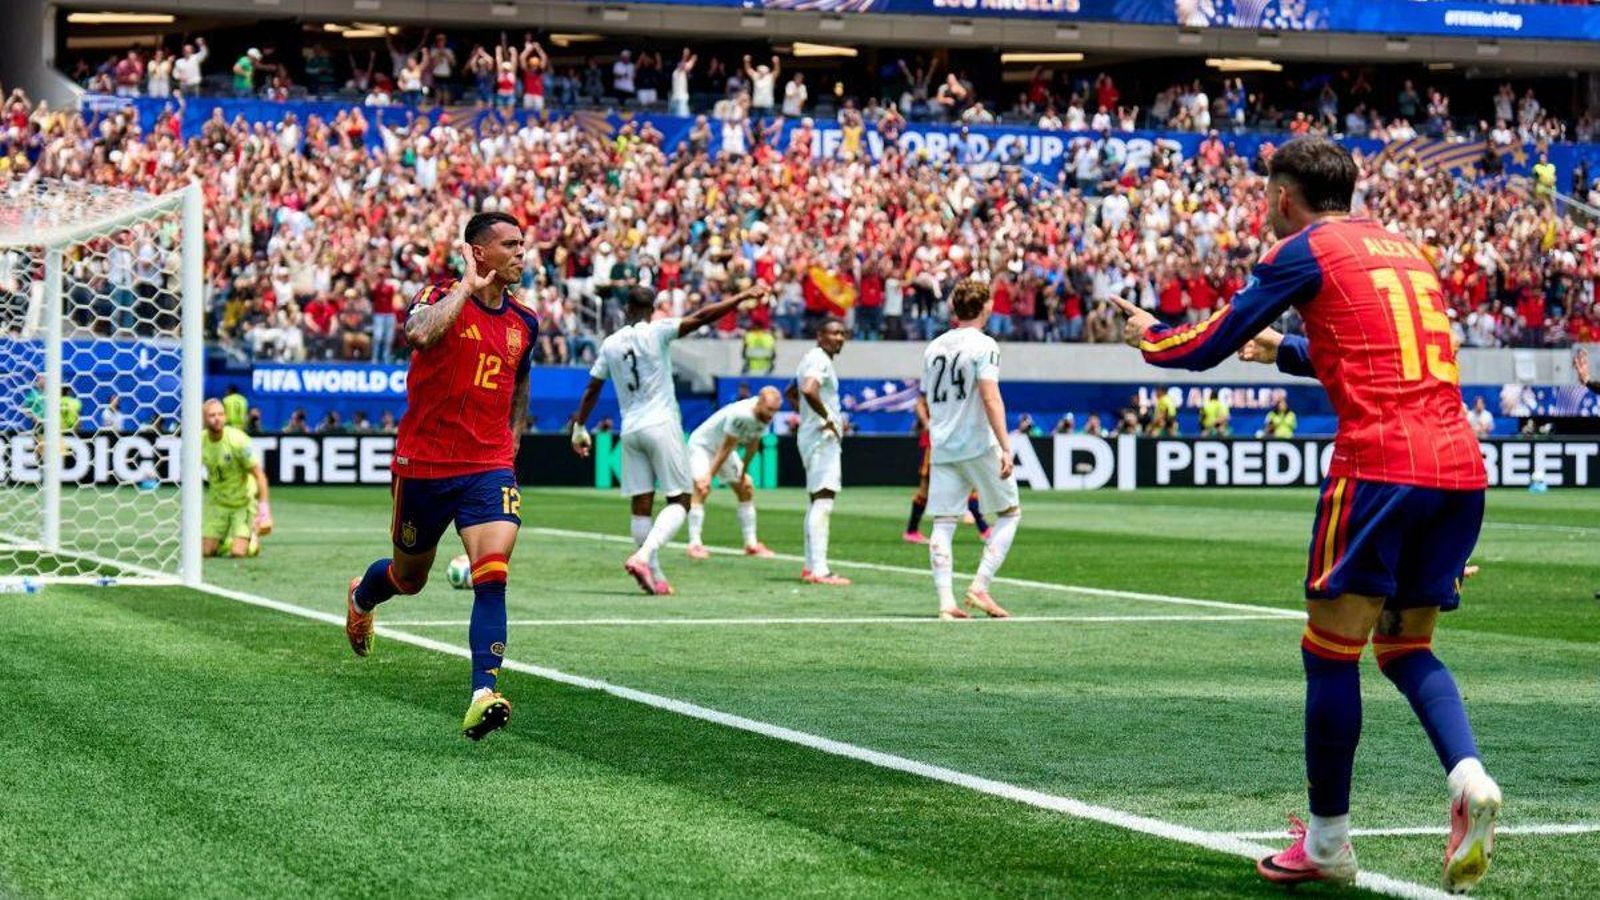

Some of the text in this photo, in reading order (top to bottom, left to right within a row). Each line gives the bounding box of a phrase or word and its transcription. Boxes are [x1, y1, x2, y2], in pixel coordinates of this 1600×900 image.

[1370, 267, 1459, 386] 15
[252, 369, 300, 392] FIFA
[302, 370, 388, 393] WORLD
[474, 352, 502, 390] 12
[623, 348, 640, 393] 3
[932, 352, 967, 404] 24
[501, 486, 522, 515] 12
